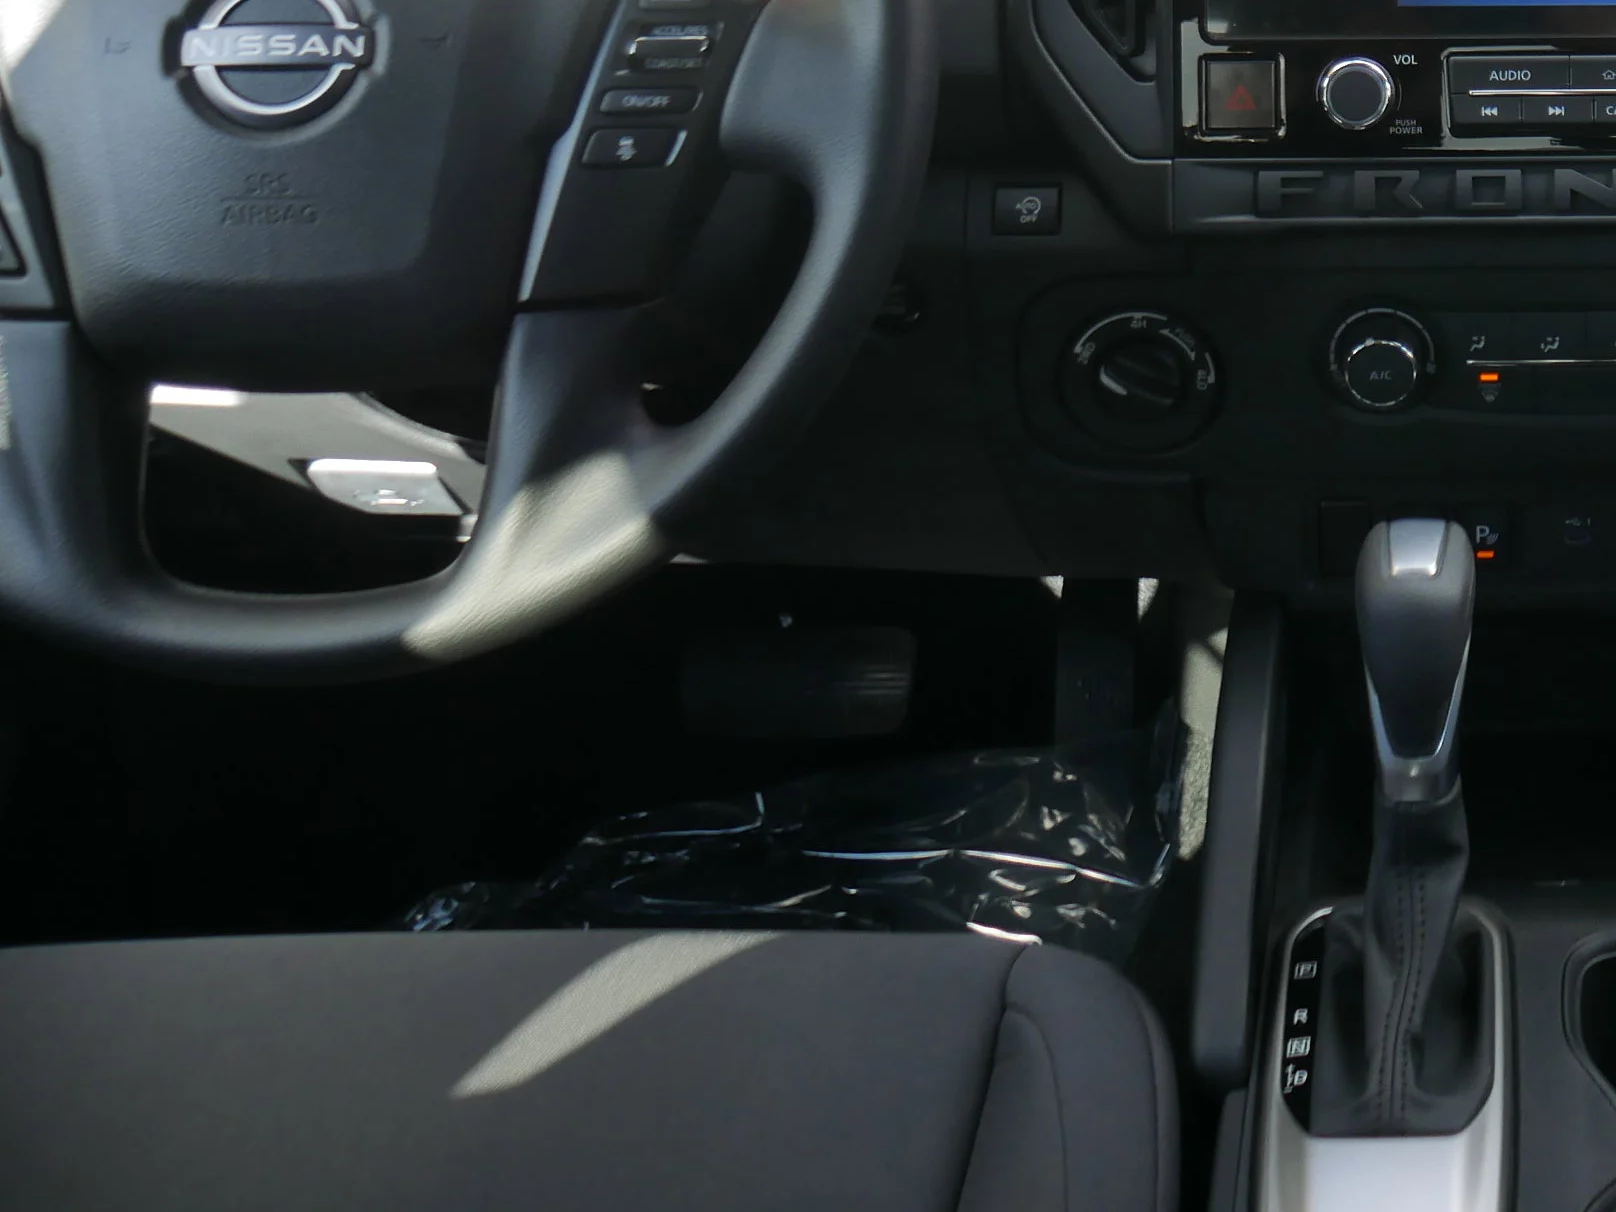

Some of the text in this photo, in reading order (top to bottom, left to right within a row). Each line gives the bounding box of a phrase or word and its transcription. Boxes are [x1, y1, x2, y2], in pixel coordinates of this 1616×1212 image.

[189, 34, 366, 58] NISSAN
[1393, 55, 1418, 65] VOL
[1489, 69, 1531, 81] AUDIO
[1389, 126, 1423, 134] POWER
[1369, 369, 1393, 381] A/C
[1476, 525, 1490, 544] P
[1294, 1008, 1308, 1025] R
